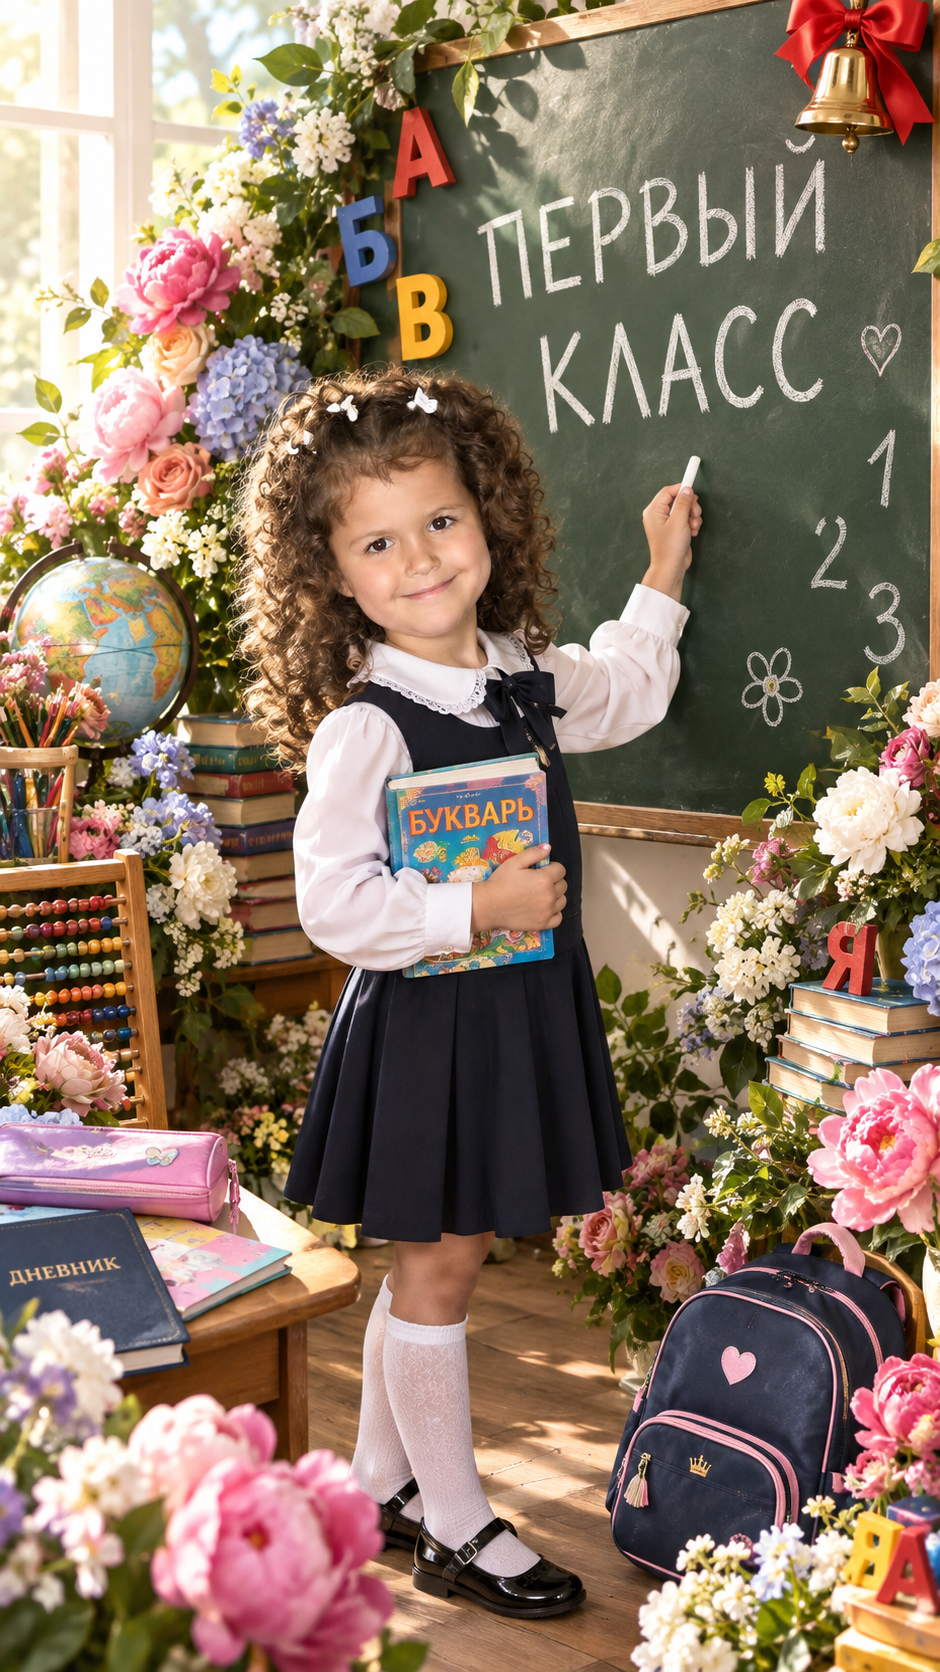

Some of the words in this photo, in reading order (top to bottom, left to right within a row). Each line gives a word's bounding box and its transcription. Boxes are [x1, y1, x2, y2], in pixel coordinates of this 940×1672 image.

[393, 106, 456, 199] А
[336, 195, 397, 287] Б
[477, 135, 826, 307] ПЕРВЫЙ
[396, 273, 453, 361] В
[540, 298, 824, 433] КЛАСС
[867, 429, 896, 508] 1
[811, 515, 848, 589] 2
[862, 582, 906, 665] 3
[408, 797, 534, 836] БУКВАРЬ
[822, 921, 878, 996] Я
[8, 1256, 121, 1287] ДНЕВНИК
